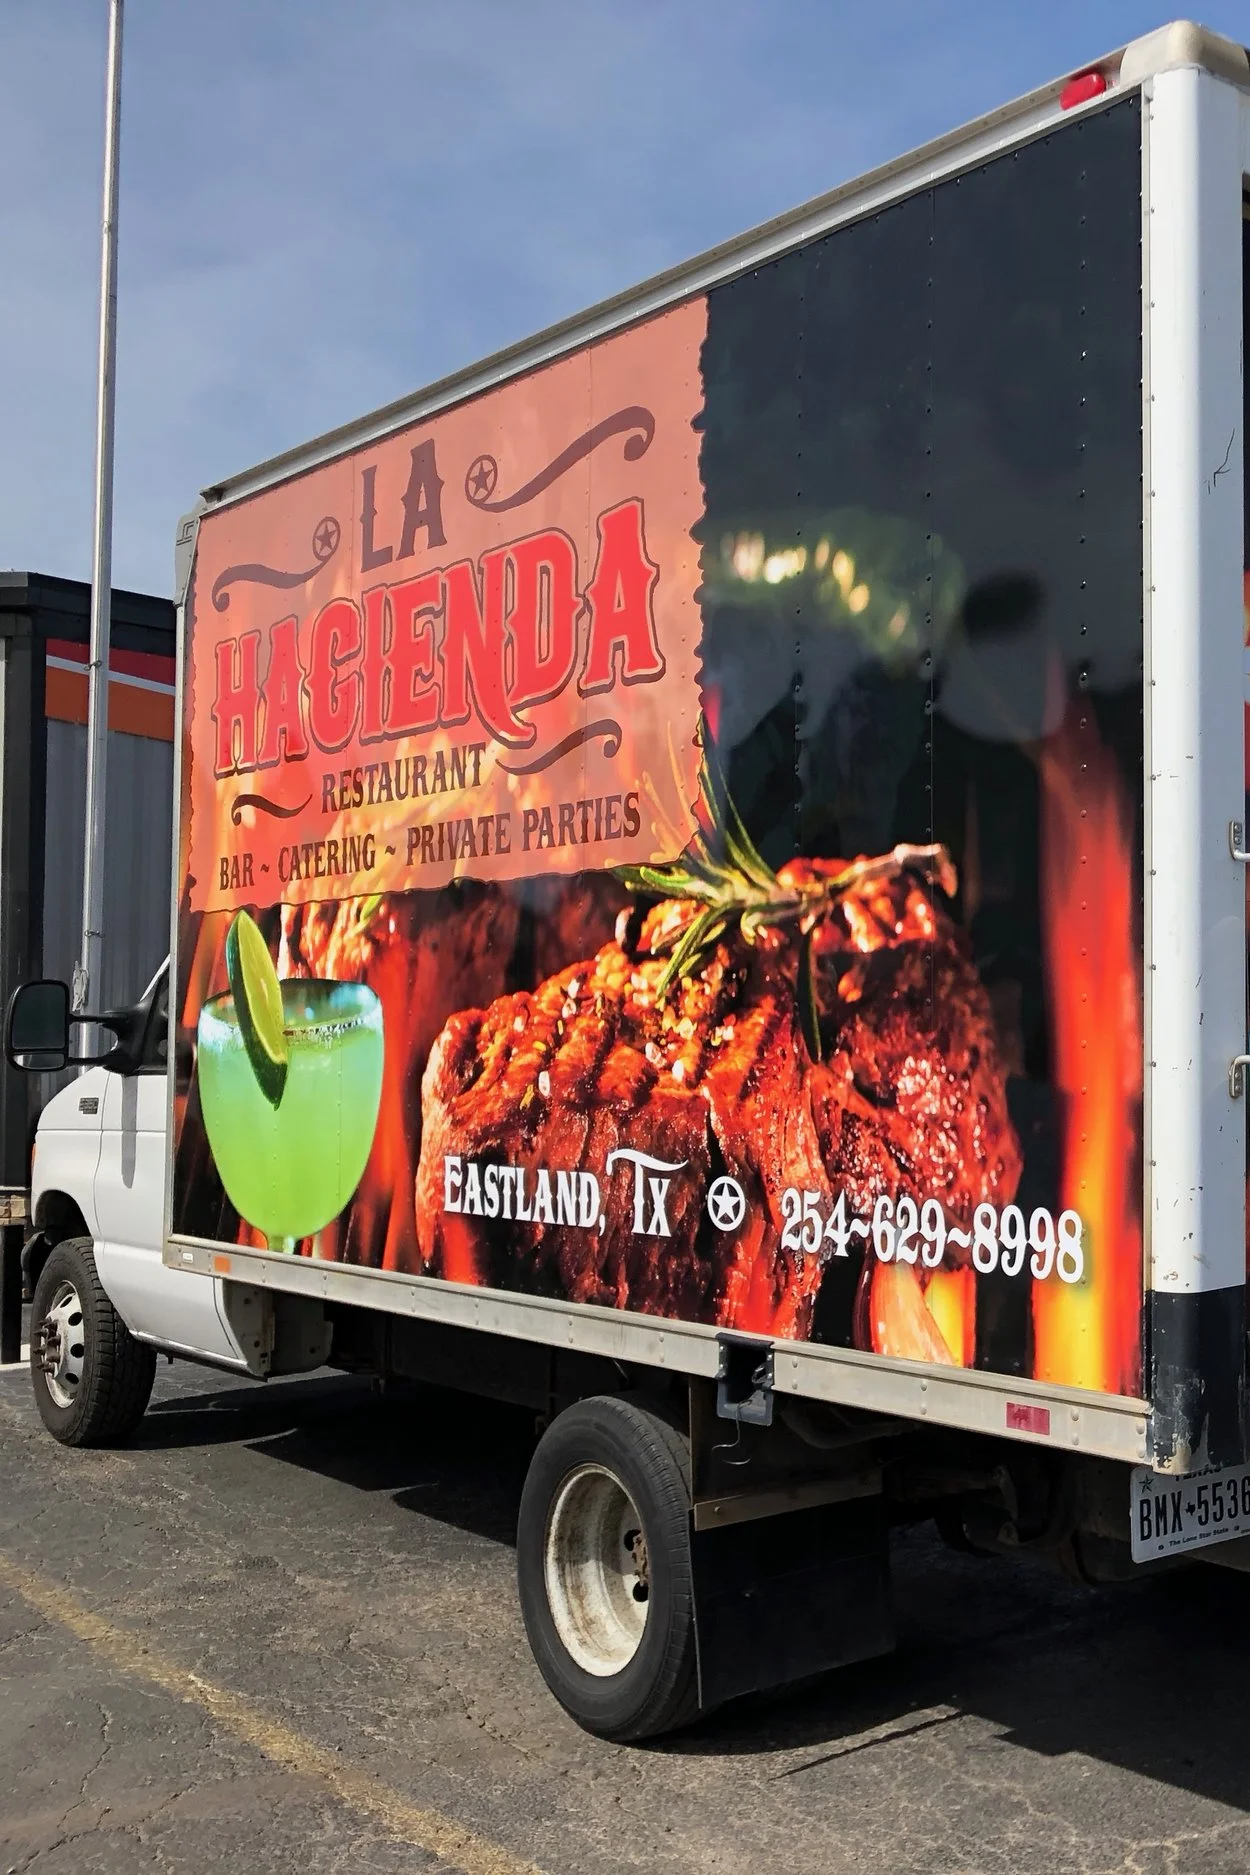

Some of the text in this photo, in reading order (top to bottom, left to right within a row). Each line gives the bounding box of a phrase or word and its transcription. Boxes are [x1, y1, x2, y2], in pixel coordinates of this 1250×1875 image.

[360, 438, 447, 573] LA
[212, 497, 666, 779] HACIENDA
[321, 741, 487, 814] RESTAURANT
[218, 853, 256, 891] BAR
[277, 833, 376, 884] CATERING
[405, 812, 512, 867] PRIVATE
[521, 791, 642, 851] PARTIES
[1139, 1490, 1183, 1542] BMX
